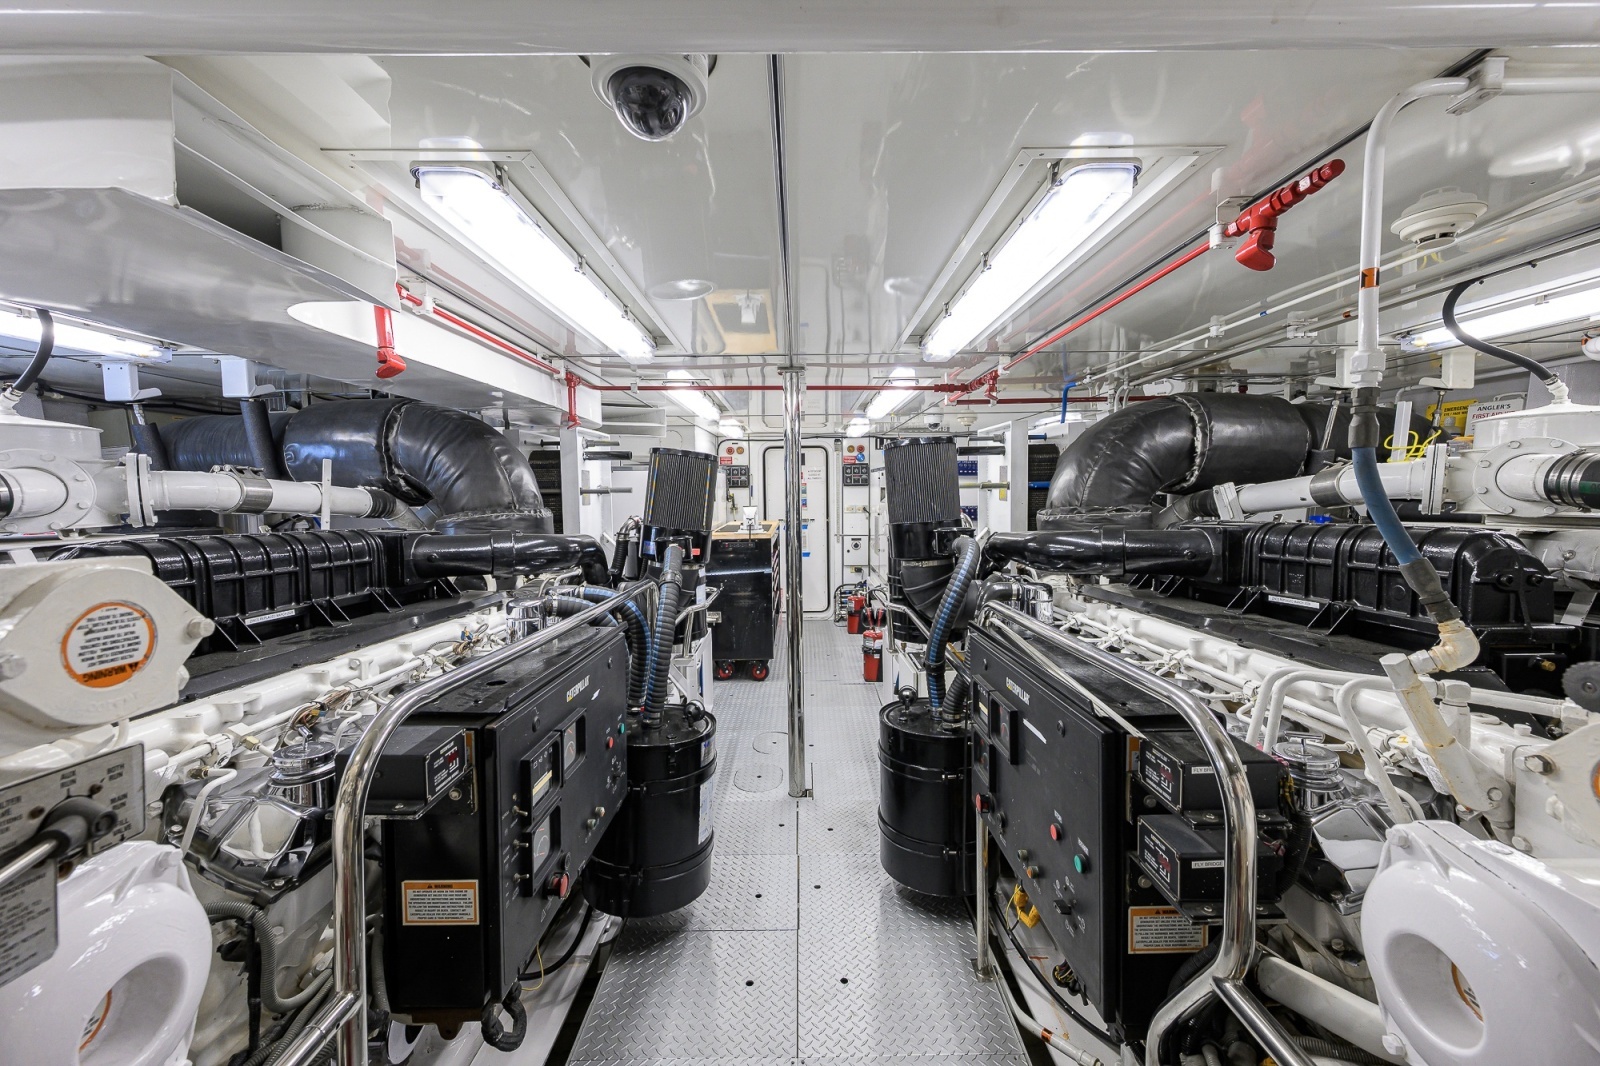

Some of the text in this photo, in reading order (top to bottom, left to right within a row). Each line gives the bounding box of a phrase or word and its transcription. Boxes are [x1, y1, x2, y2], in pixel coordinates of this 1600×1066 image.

[82, 666, 127, 682] WARNING
[566, 674, 590, 703] CATERPILLAR
[1006, 676, 1030, 706] CATERPILLAR
[107, 763, 124, 774] BOTH
[60, 769, 76, 780] AUX
[109, 771, 124, 781] RUN
[60, 778, 76, 788] RUN
[112, 800, 126, 810] RUN
[113, 823, 132, 836] VALVE
